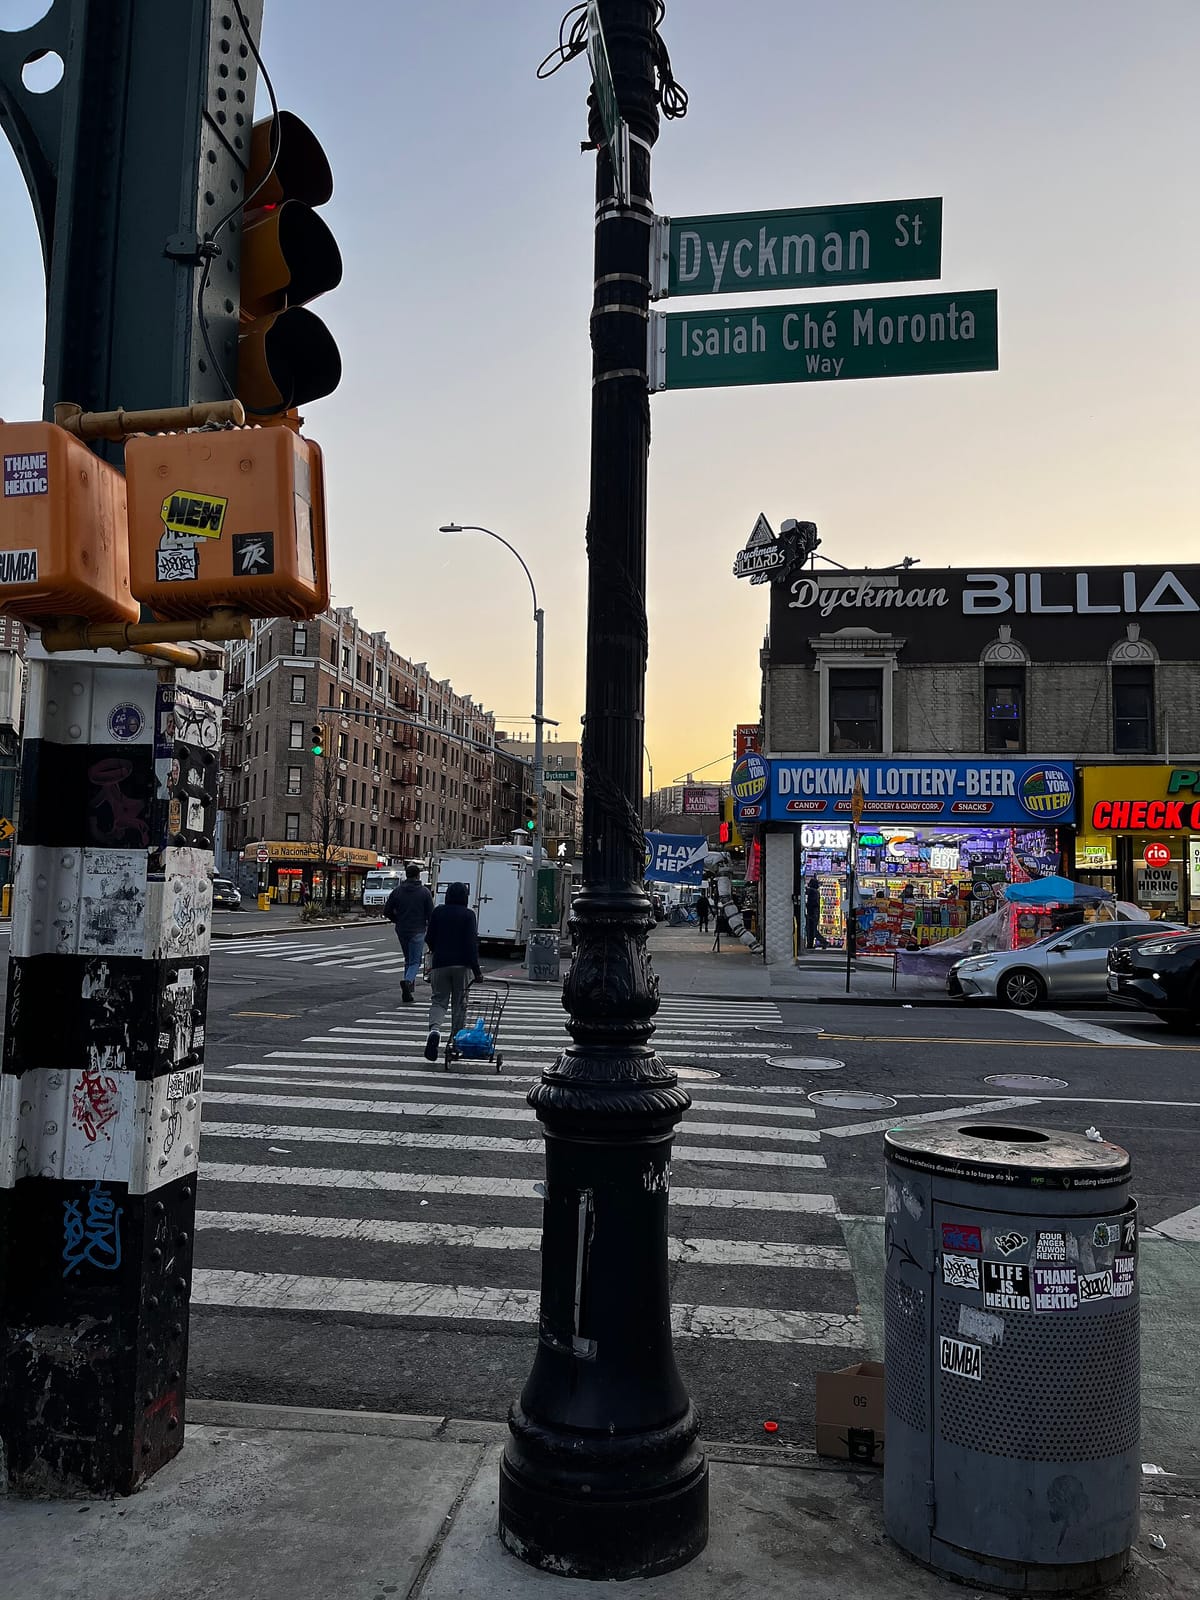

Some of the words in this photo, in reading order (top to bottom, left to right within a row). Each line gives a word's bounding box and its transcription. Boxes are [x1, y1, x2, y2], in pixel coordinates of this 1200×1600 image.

[678, 226, 870, 292] Dyckman
[894, 214, 922, 247] St
[682, 316, 766, 357] Isaiah
[783, 310, 837, 351] Ché
[853, 302, 976, 346] Moronta
[805, 355, 845, 376] Way
[4, 455, 47, 471] THANE
[5, 478, 48, 495] HEKTIC
[166, 496, 224, 531] NEW
[736, 545, 778, 561] Dyckman
[733, 549, 785, 575] BILLIARDS
[749, 572, 768, 585] Cafe
[788, 578, 949, 617] Dyckman
[748, 757, 761, 767] NEW
[546, 772, 569, 780] Dyckman
[749, 765, 765, 779] YORK
[1045, 770, 1064, 781] NEW
[778, 768, 870, 795] DYCKMAN
[876, 768, 1015, 796] LOTTERY-BEER
[1047, 779, 1069, 793] YORK
[958, 803, 987, 811] SNACKS
[1024, 791, 1072, 811] LOTTERY
[1092, 801, 1185, 829] CHECK
[801, 829, 849, 848] OPEN
[271, 847, 279, 855] La
[281, 847, 309, 855] Nacional
[657, 844, 697, 858] PLAY
[1147, 845, 1167, 858] ria
[655, 858, 692, 873] HER
[931, 853, 959, 870] EBT
[1144, 870, 1172, 880] NOW
[1138, 881, 1178, 891] HIRING
[991, 1264, 1023, 1280] LIFE
[1035, 1270, 1077, 1285] THANE
[986, 1292, 1030, 1310] HEKTIC
[1036, 1294, 1078, 1309] HEKTIC
[942, 1340, 980, 1377] GUMBA
